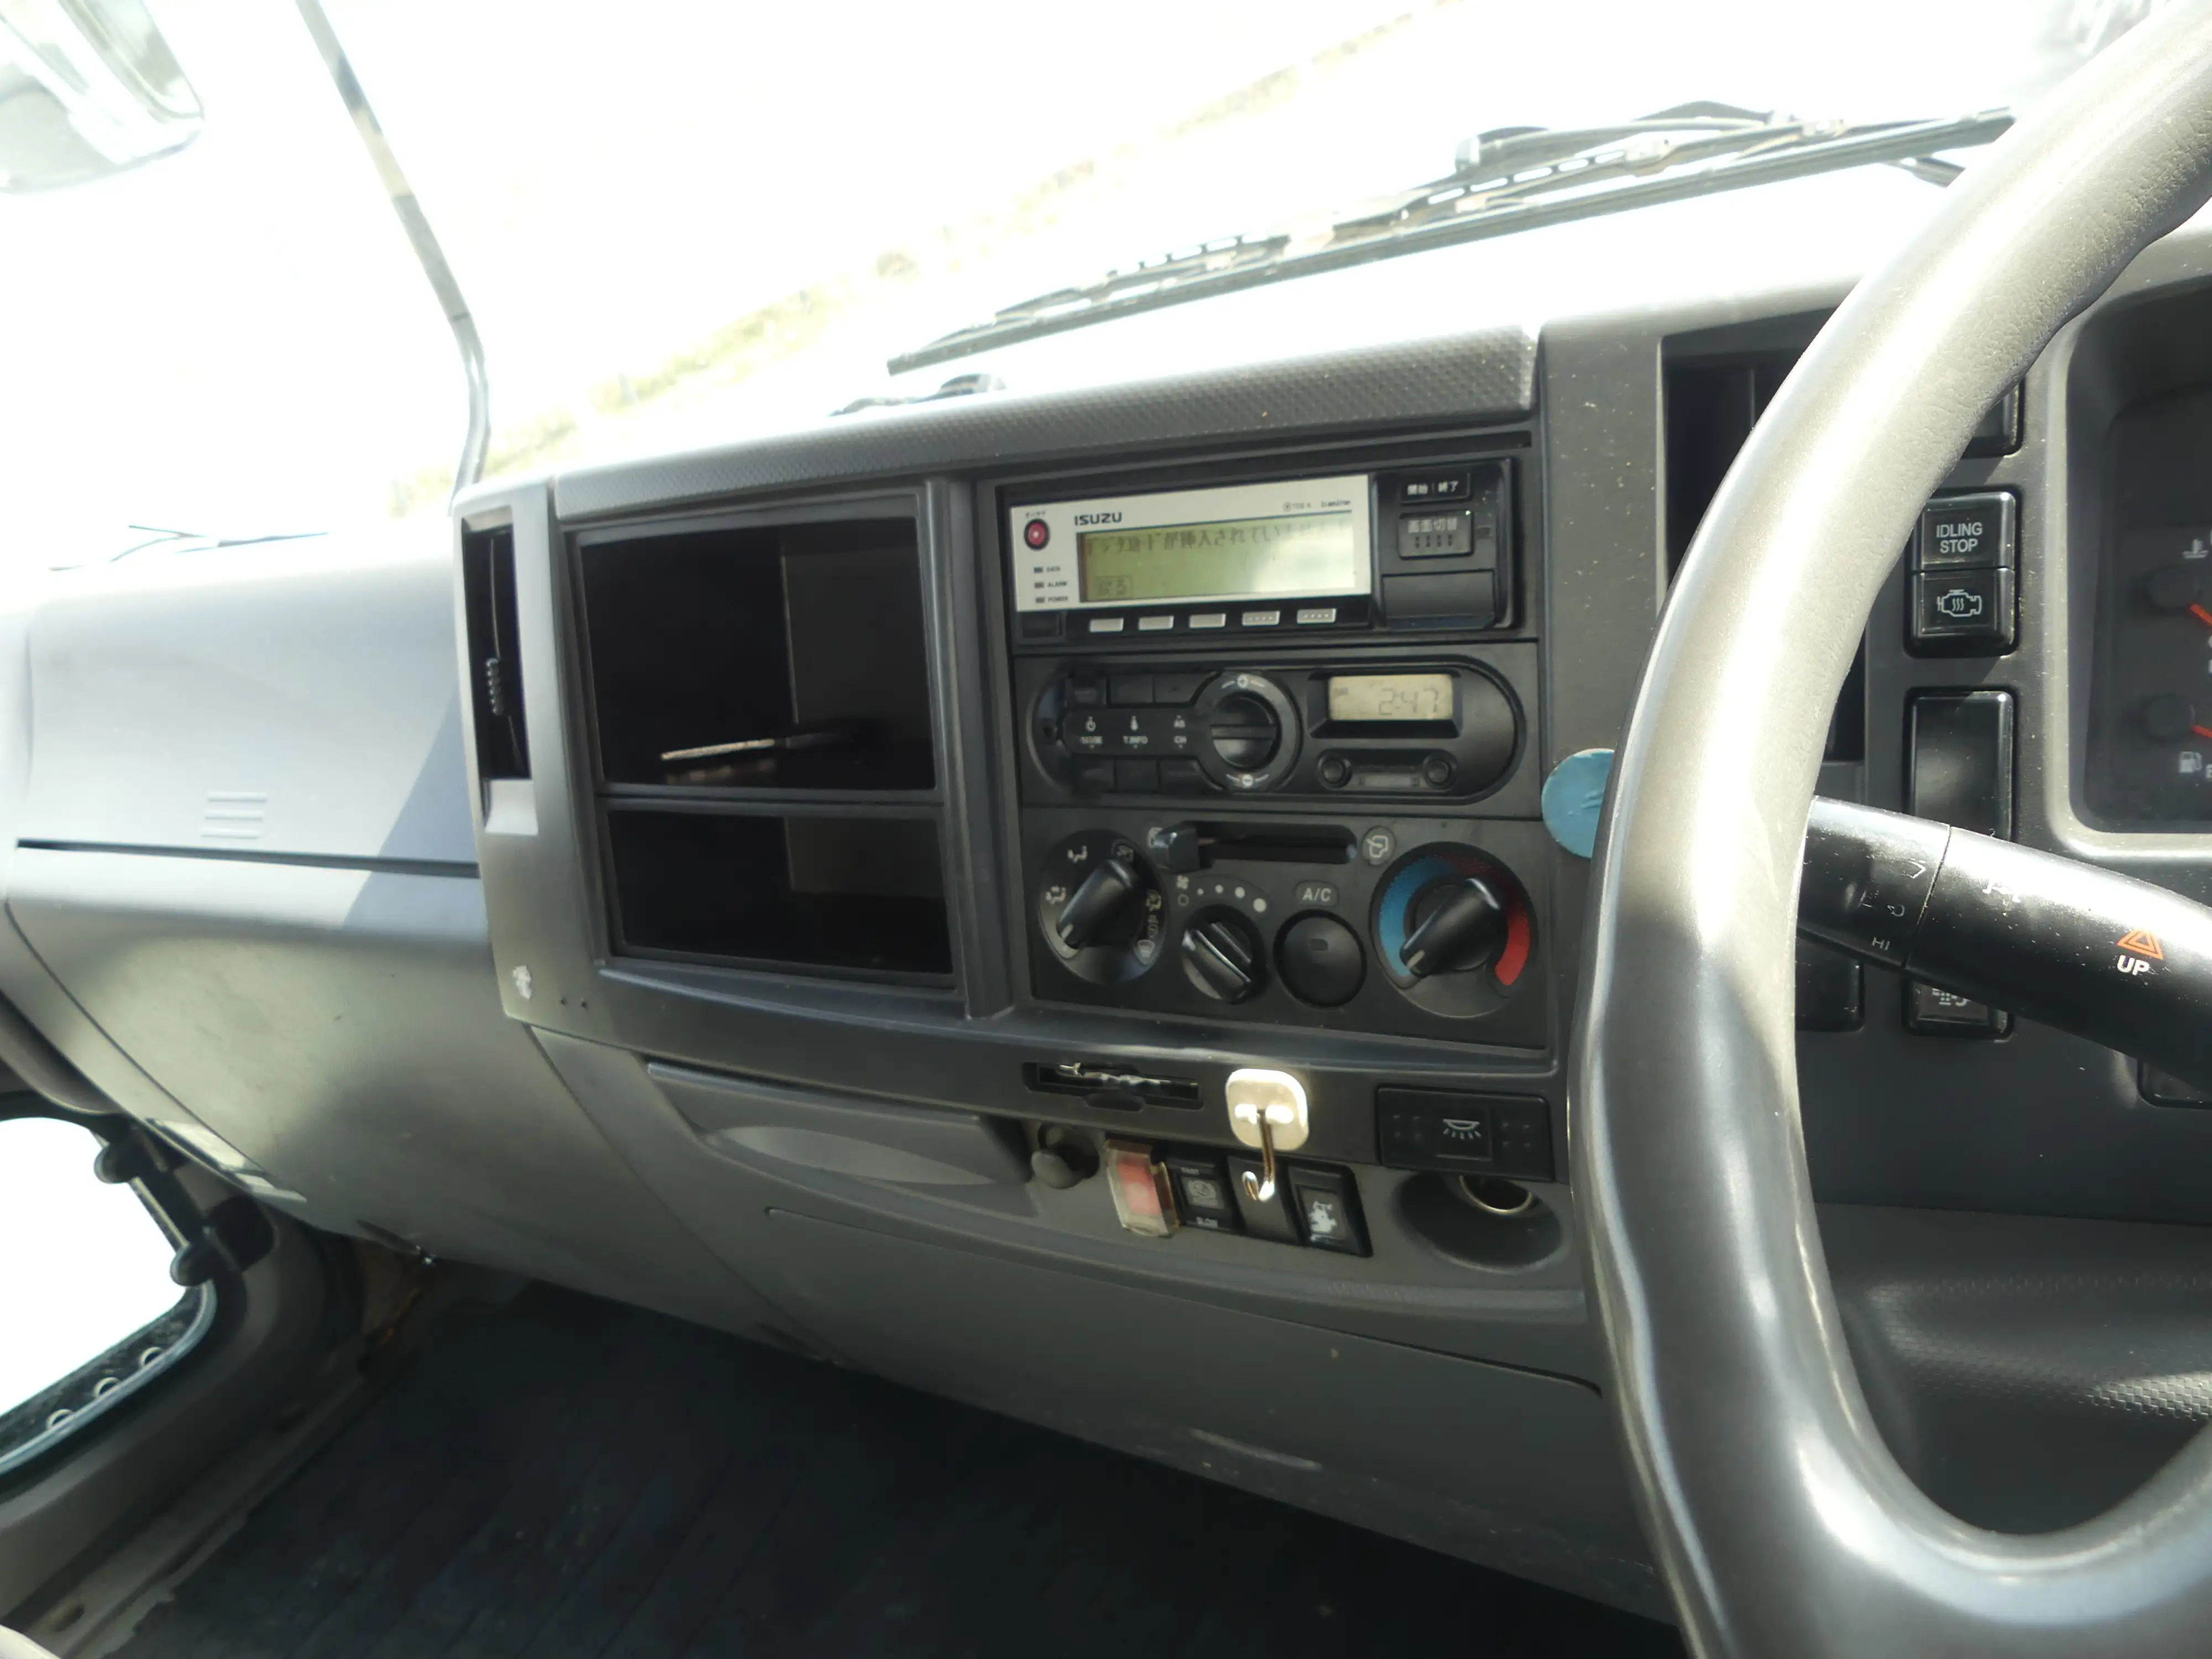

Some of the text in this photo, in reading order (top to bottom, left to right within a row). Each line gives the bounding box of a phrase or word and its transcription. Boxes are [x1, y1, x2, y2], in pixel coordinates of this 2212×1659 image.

[1074, 512, 1122, 526] ISUZU
[1936, 521, 1983, 538] IDLING
[1940, 538, 1979, 554] STOP
[1379, 687, 1439, 716] 2:47
[1302, 887, 1332, 902] A/C
[1871, 936, 1891, 951] HI
[2117, 954, 2150, 976] UP
